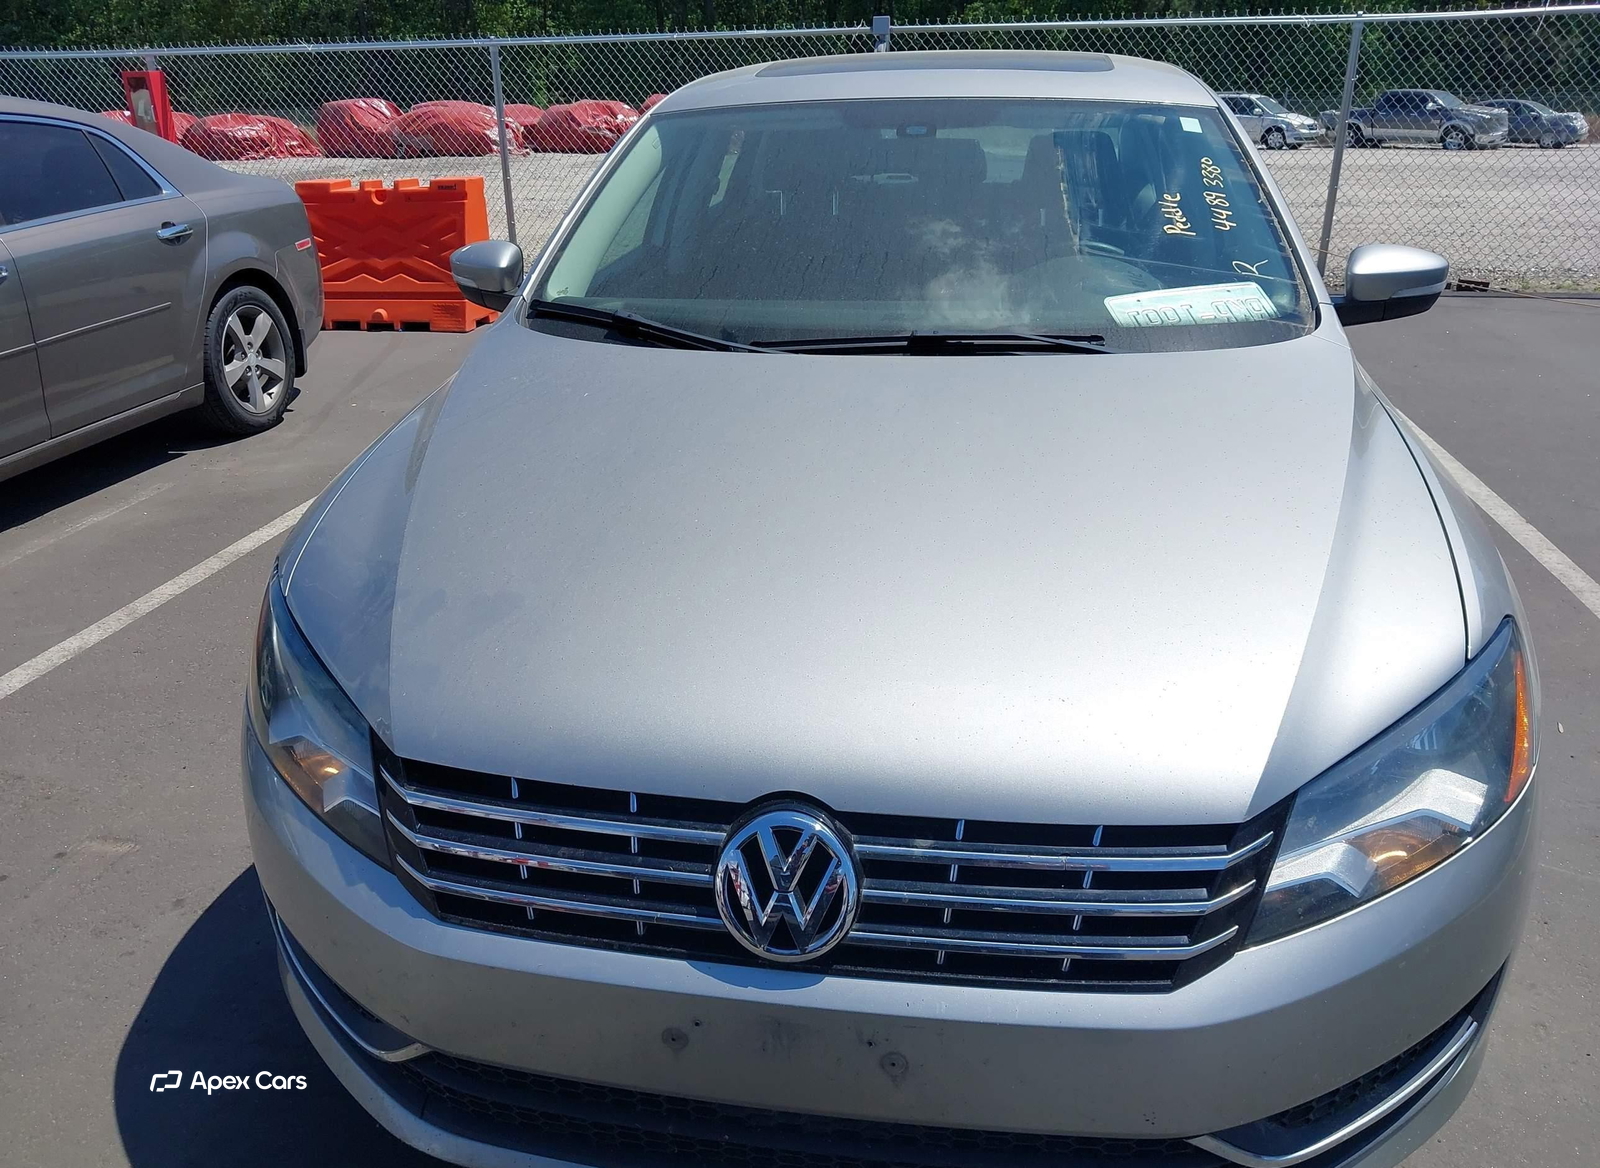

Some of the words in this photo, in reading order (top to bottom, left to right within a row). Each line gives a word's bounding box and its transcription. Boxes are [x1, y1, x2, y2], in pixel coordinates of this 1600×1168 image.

[1158, 192, 1197, 236] Peddle
[1203, 191, 1237, 231] 4489
[717, 811, 856, 960] VW
